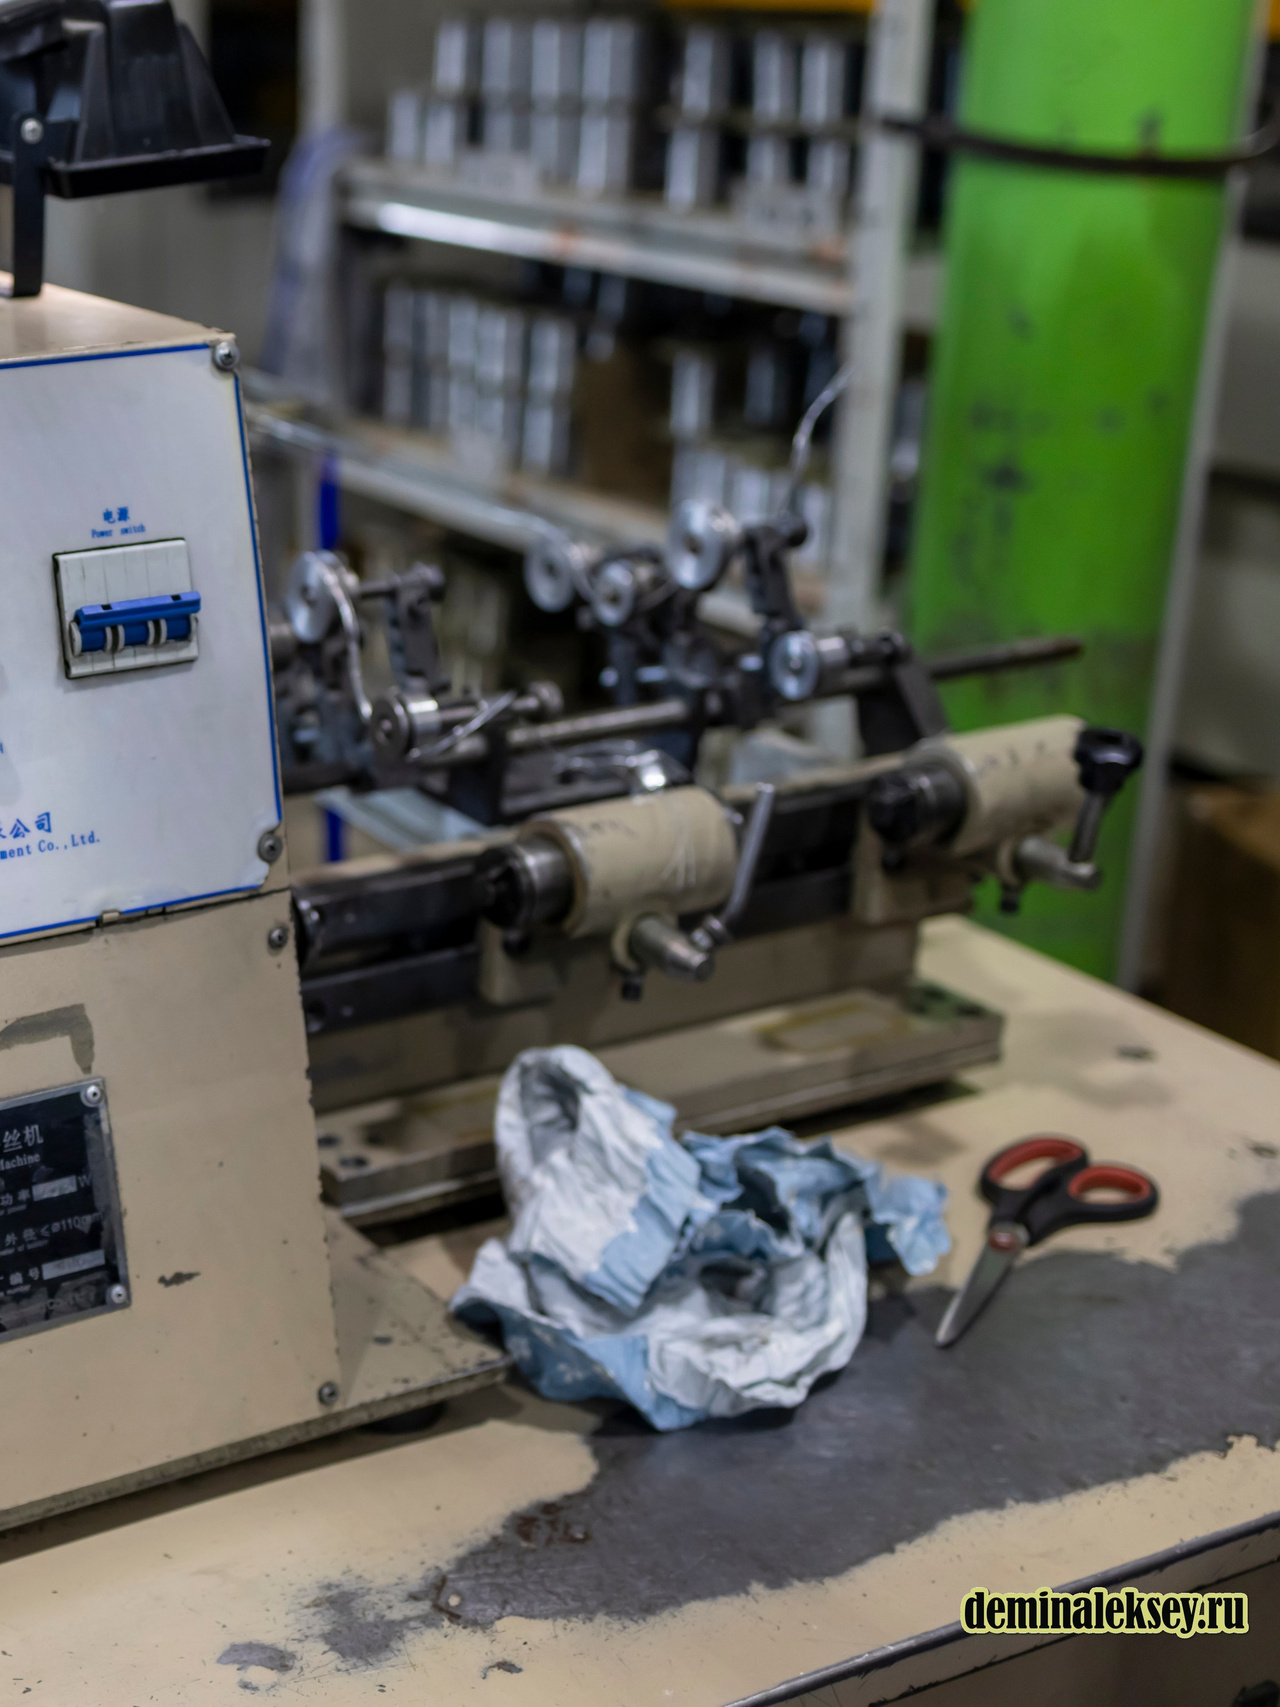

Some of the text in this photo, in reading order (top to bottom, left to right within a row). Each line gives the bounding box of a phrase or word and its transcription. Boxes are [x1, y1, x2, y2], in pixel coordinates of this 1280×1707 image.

[103, 506, 130, 524] 电源
[91, 524, 146, 538] Power switch
